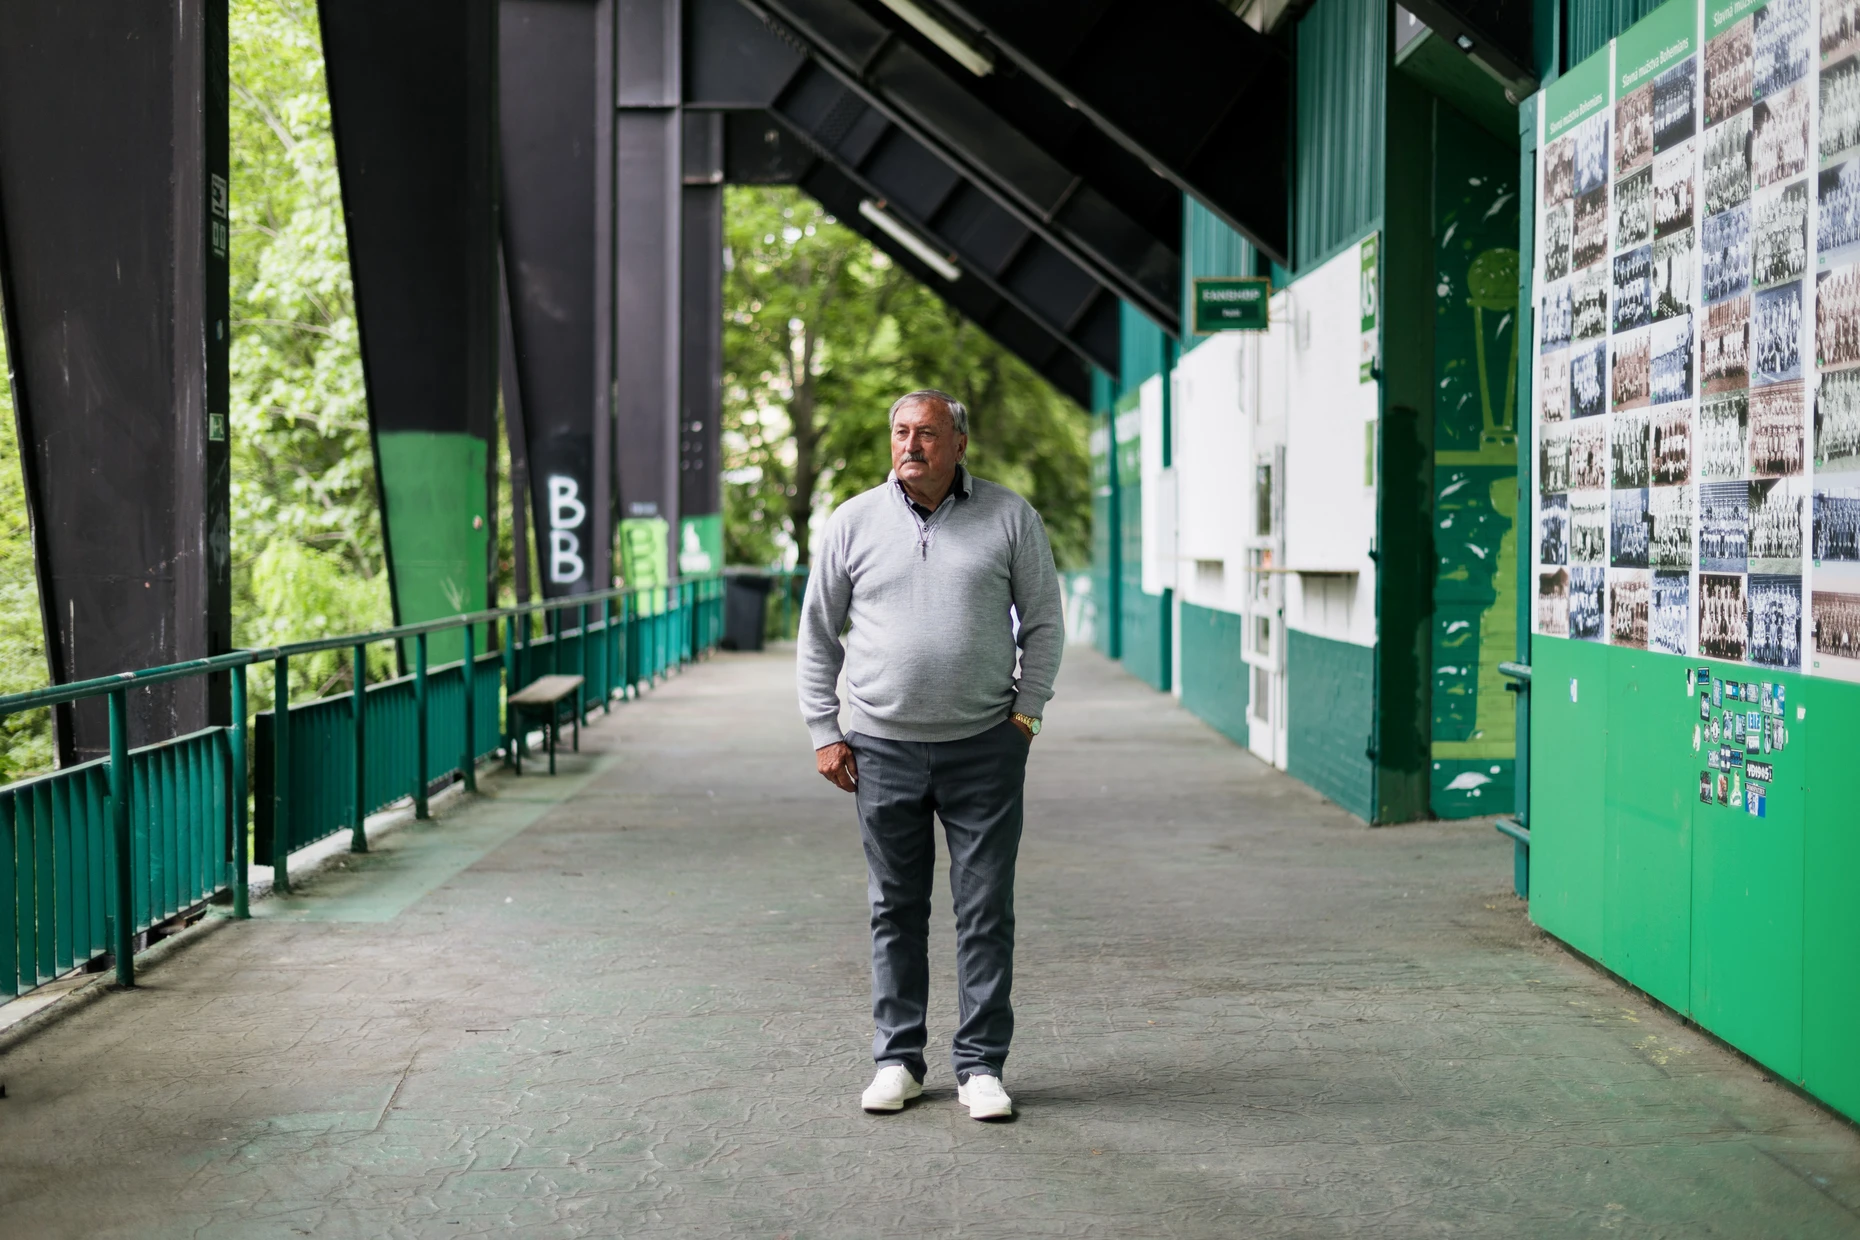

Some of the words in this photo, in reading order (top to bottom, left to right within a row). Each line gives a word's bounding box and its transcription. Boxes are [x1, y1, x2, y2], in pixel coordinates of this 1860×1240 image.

[1713, 2, 1733, 27] Slavná
[1622, 67, 1638, 88] Slavná
[1660, 37, 1689, 64] Bohemians
[1579, 93, 1603, 116] Bohemians
[1202, 288, 1261, 301] FANSHOP
